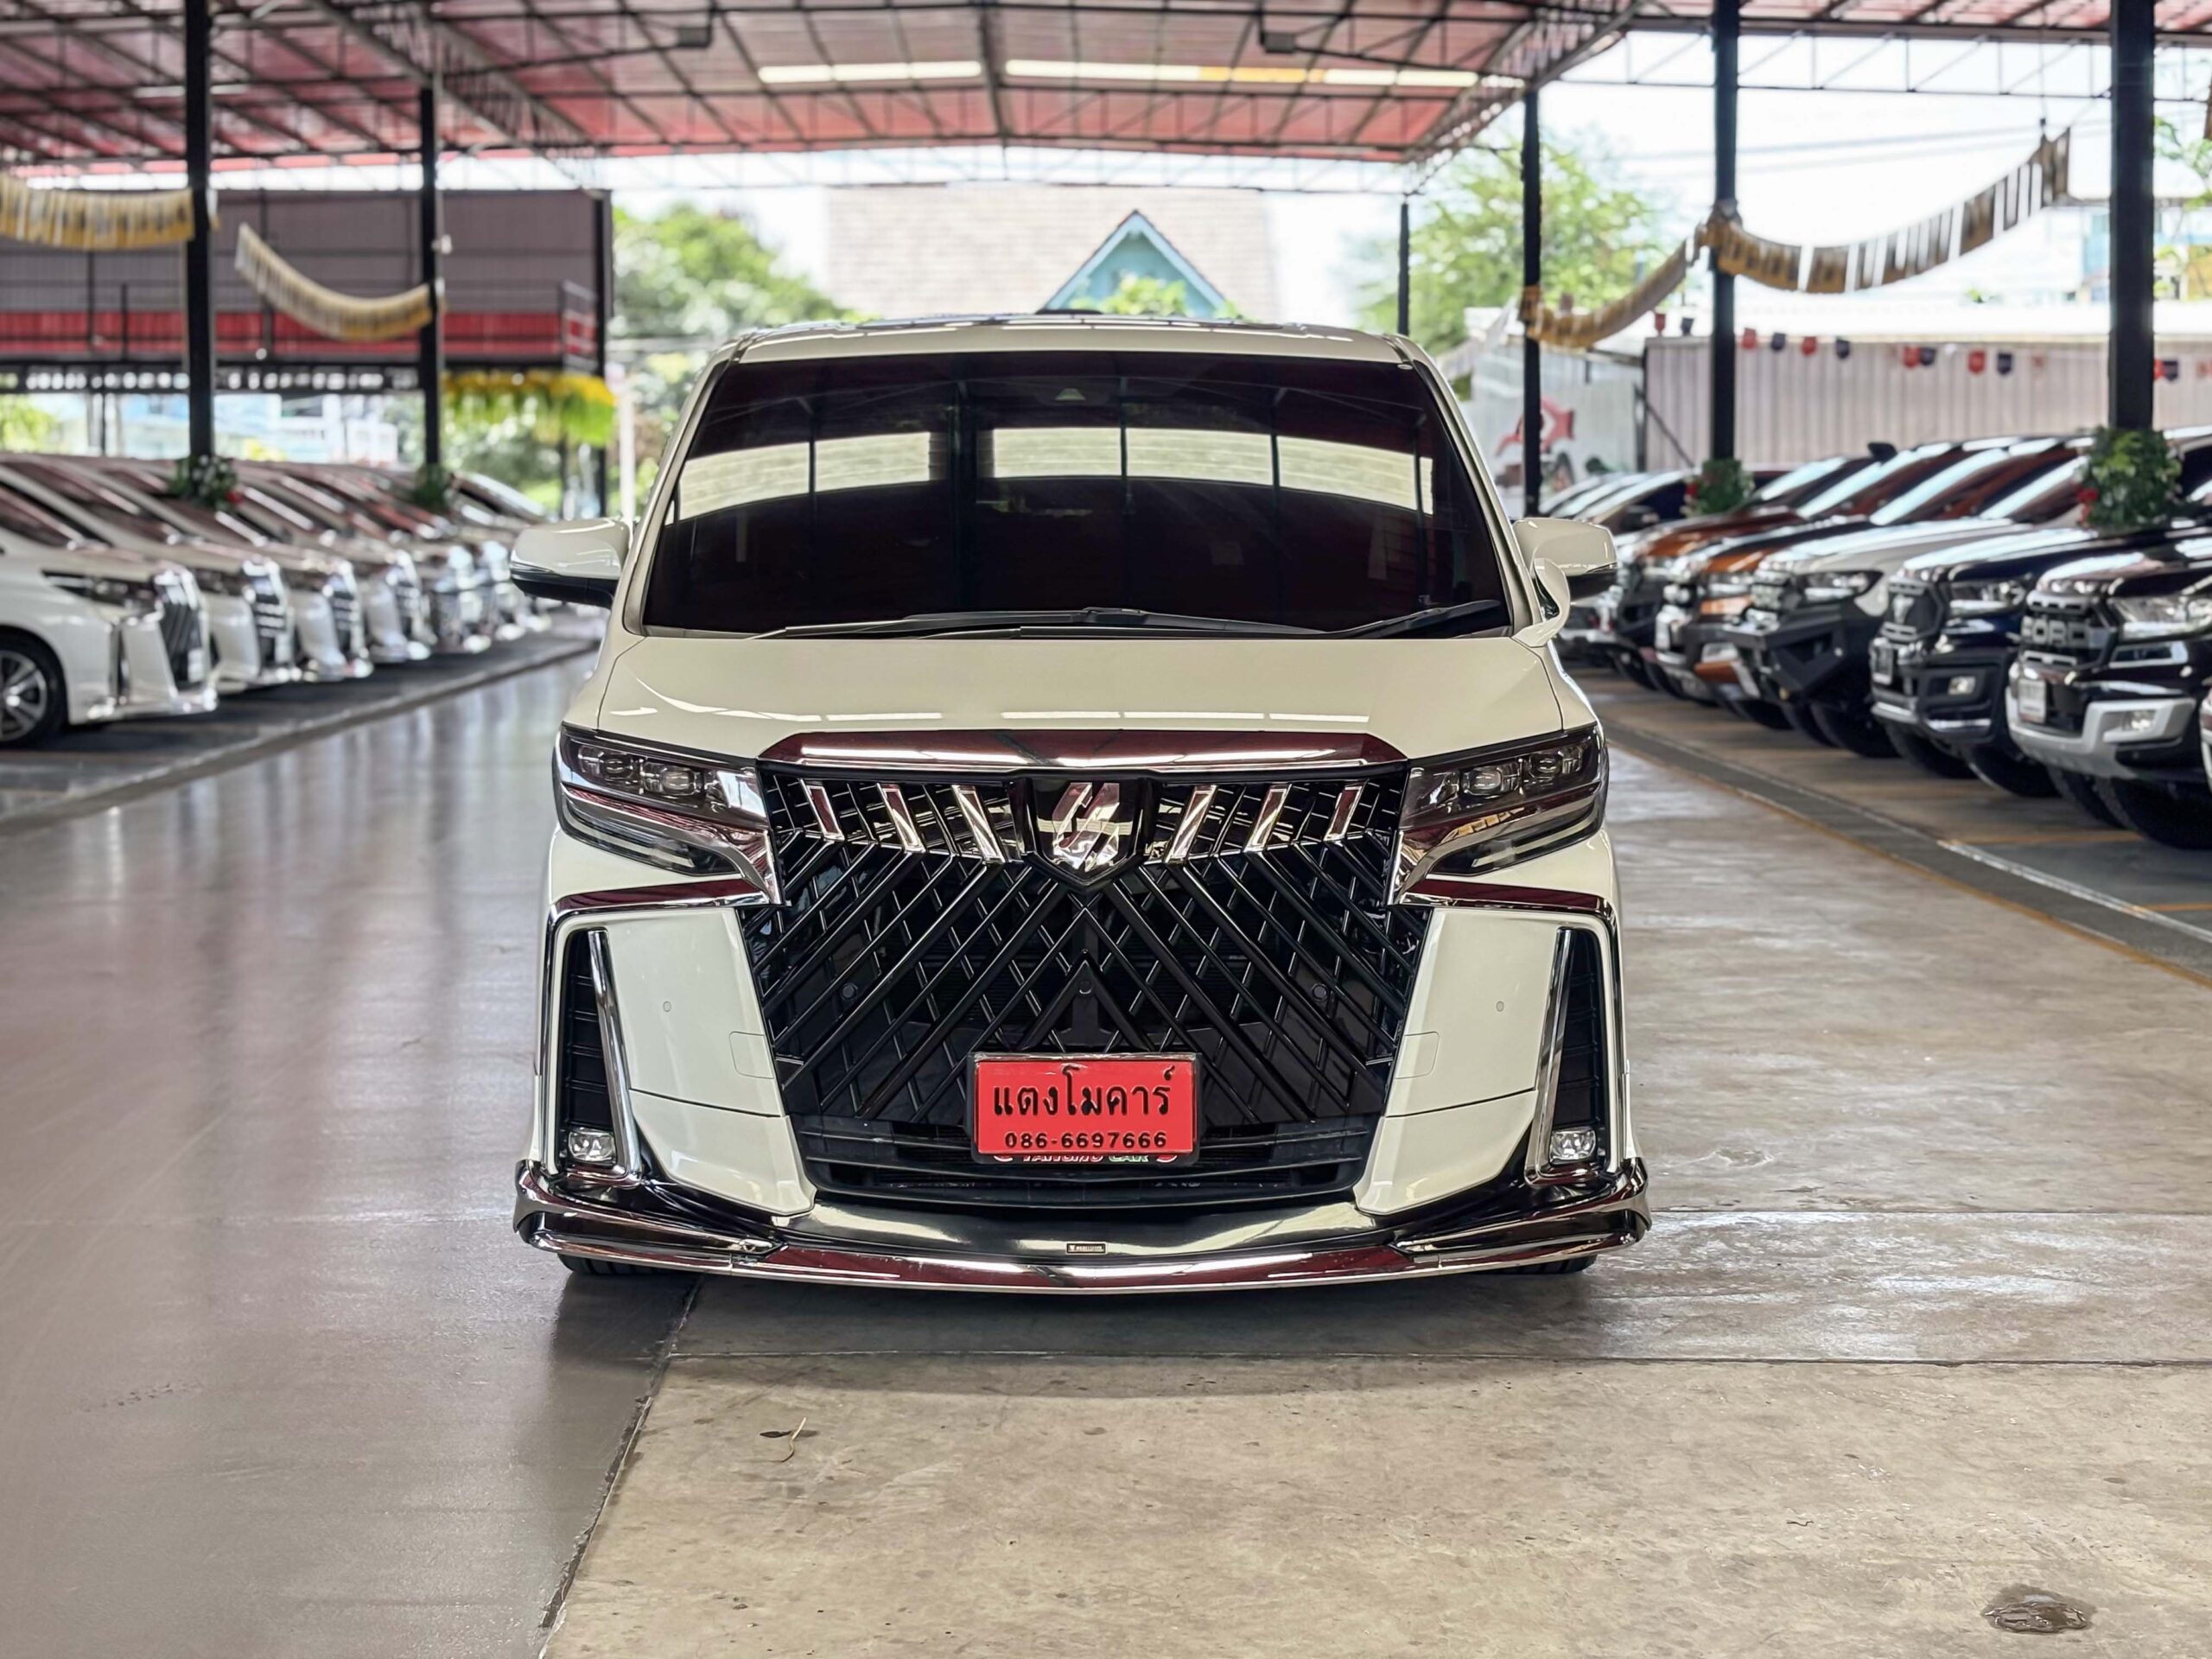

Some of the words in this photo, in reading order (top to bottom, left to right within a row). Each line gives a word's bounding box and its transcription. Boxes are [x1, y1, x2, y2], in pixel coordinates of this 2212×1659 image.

[994, 1065, 1175, 1116] แตงโมคาร์
[1004, 1131, 1166, 1148] 086-6697666
